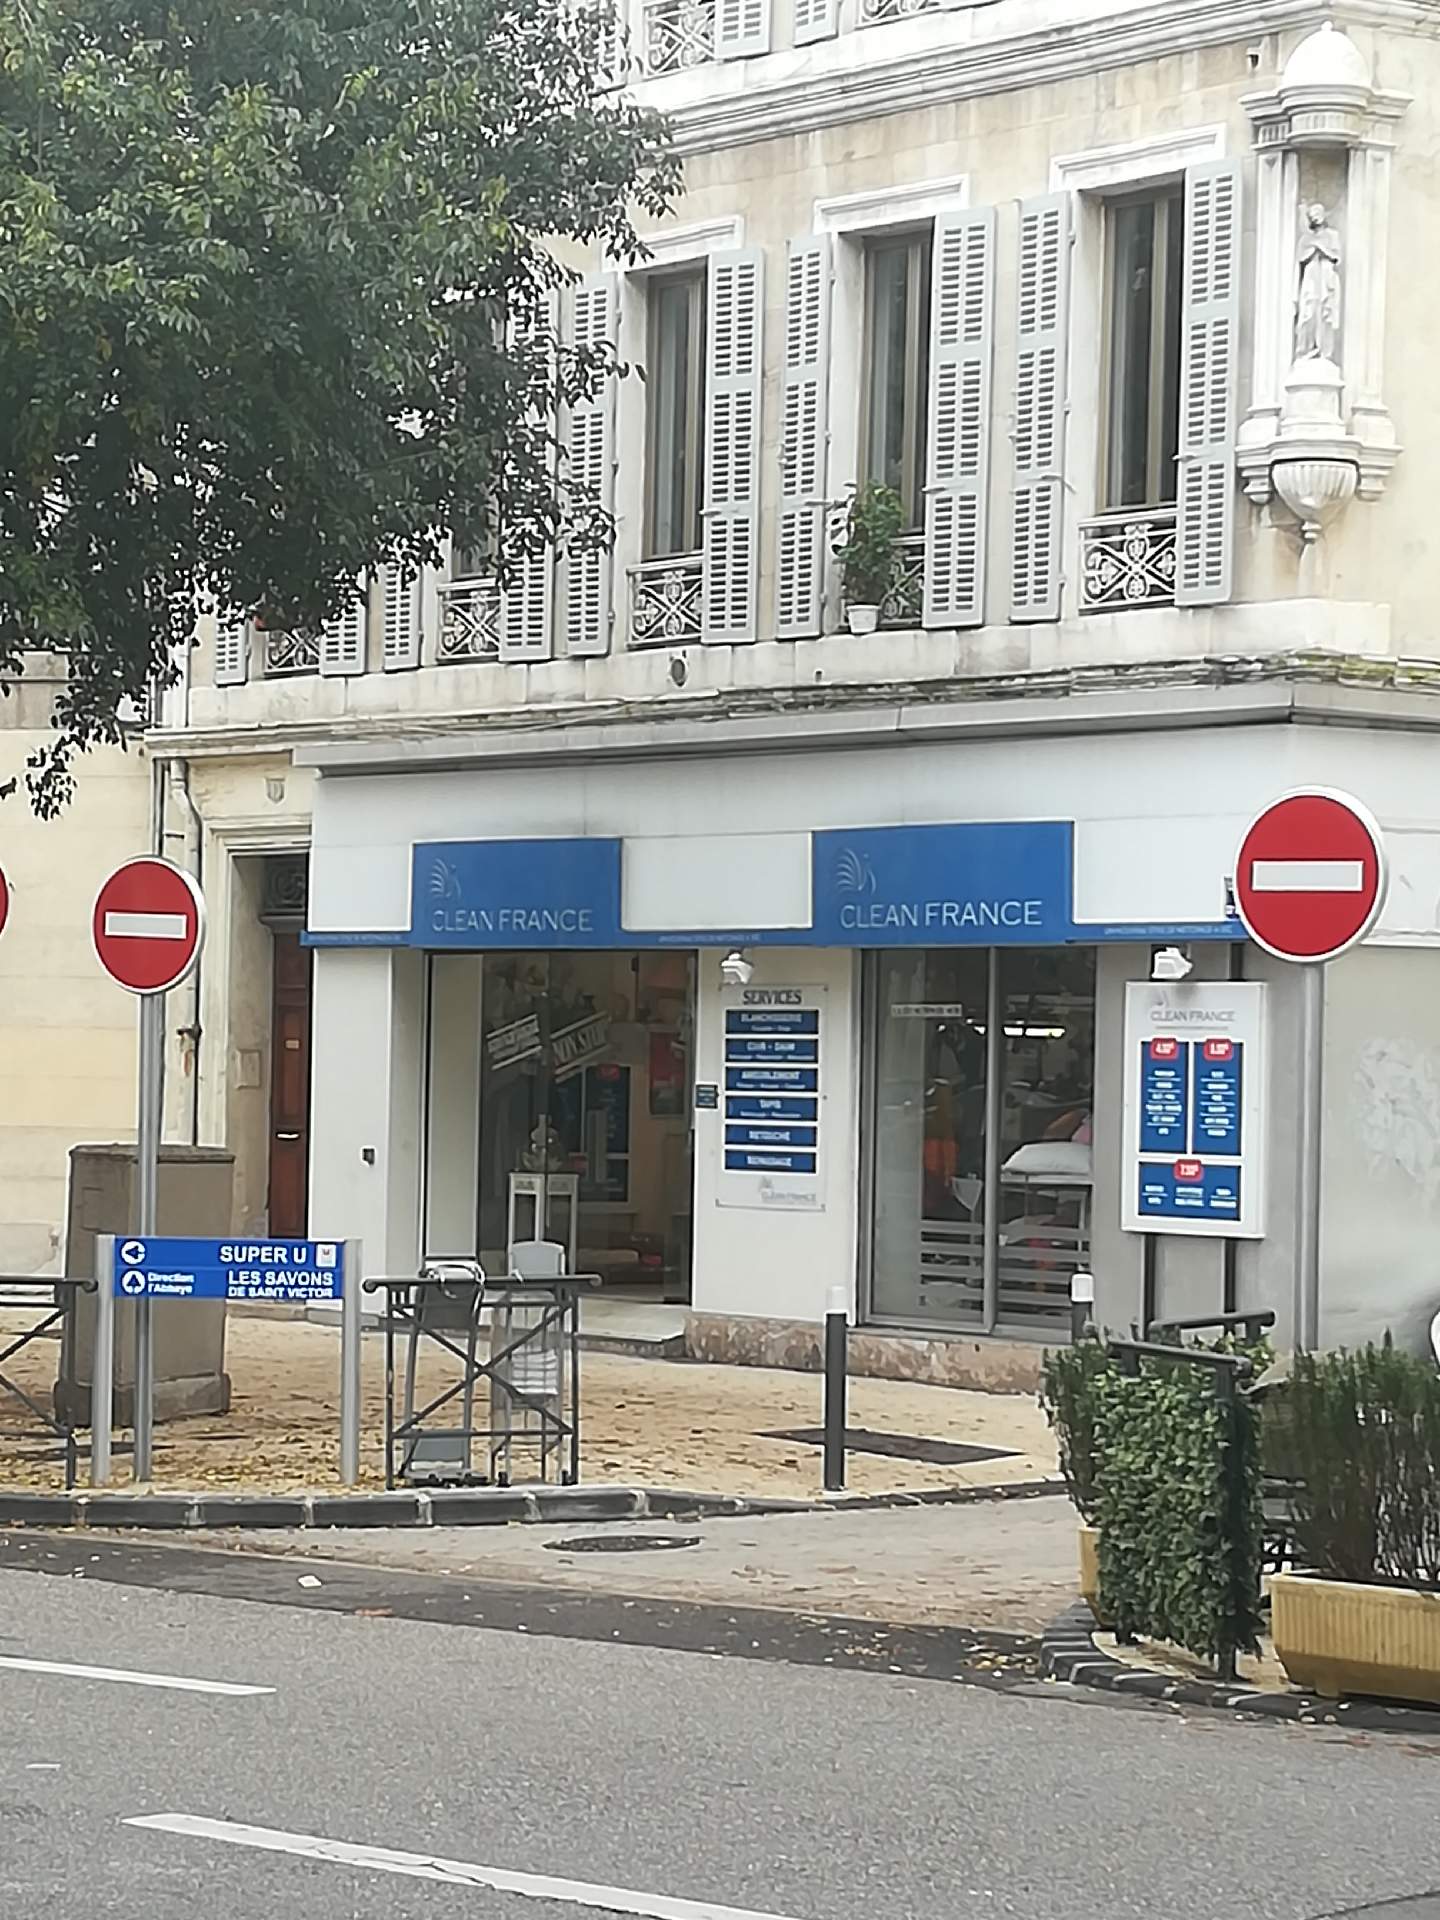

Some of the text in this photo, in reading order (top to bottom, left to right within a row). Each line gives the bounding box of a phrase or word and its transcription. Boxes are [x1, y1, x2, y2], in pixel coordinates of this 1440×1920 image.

[431, 908, 594, 932] CLEAN FRANCE
[839, 900, 1043, 929] CLEAN FRANCE
[743, 989, 802, 1005] SERVICES
[1150, 1010, 1236, 1021] CLEAN FRANCE
[220, 1245, 289, 1264] SUPER
[294, 1247, 307, 1264] U
[228, 1270, 334, 1286] LES SAVONS
[228, 1286, 334, 1298] DE SAINT VICTOR
